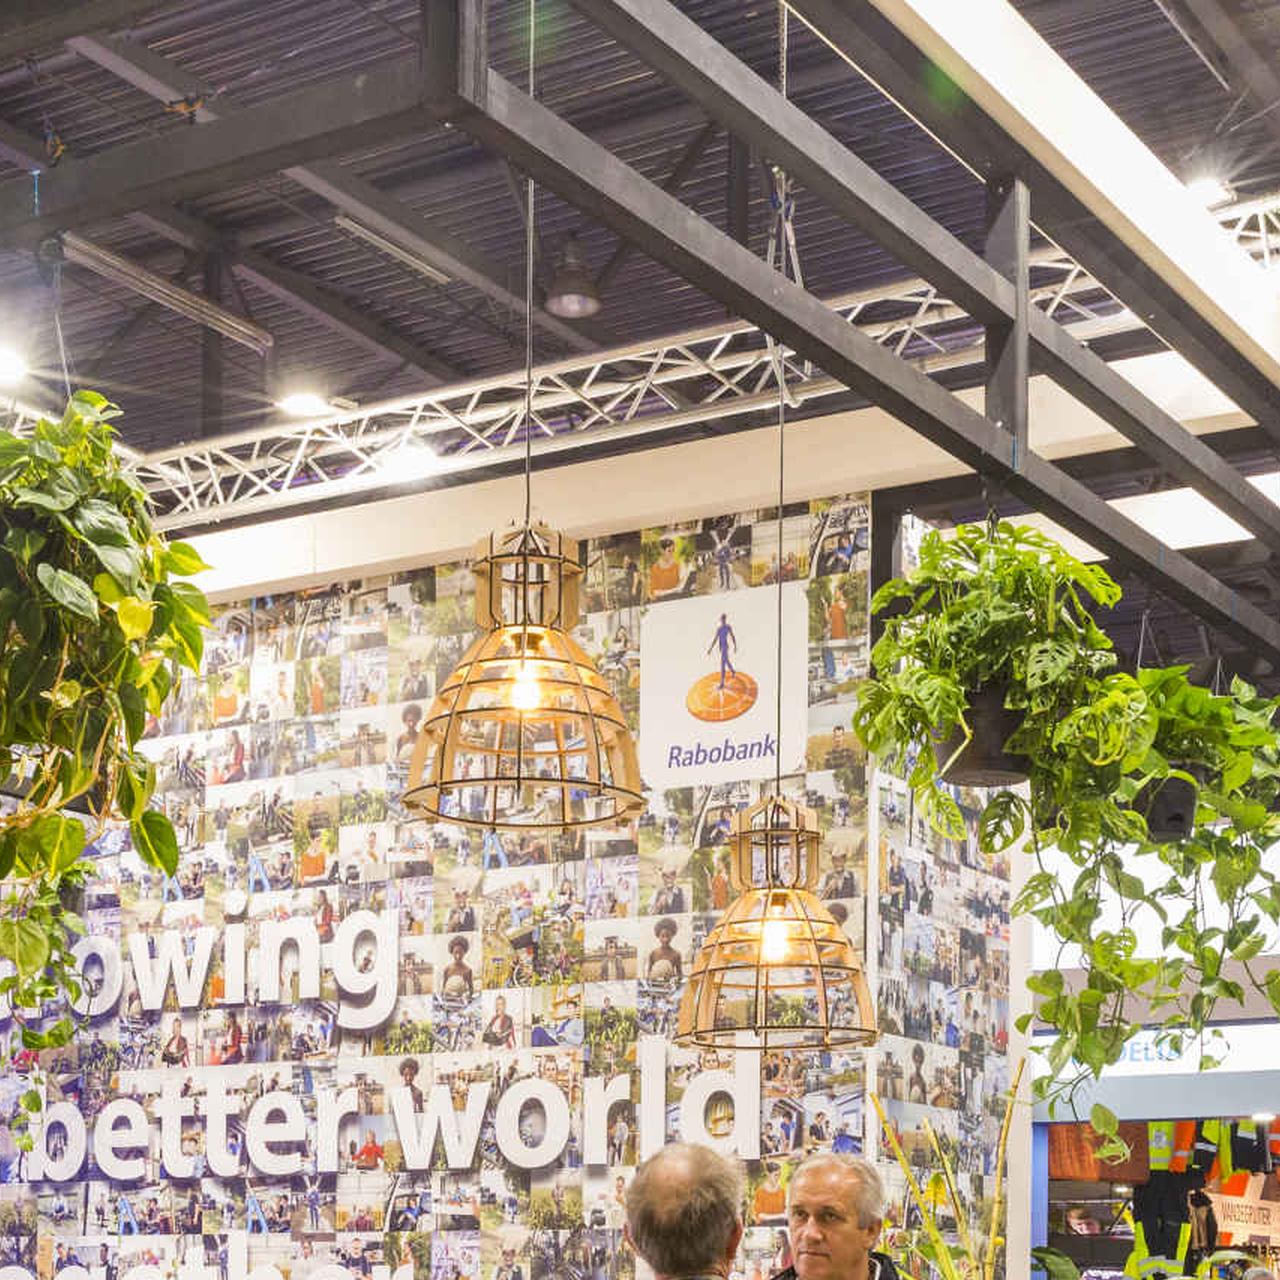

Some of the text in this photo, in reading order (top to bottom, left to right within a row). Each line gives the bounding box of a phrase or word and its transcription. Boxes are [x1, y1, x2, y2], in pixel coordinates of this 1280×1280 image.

[667, 733, 776, 769] Rabobank
[26, 1072, 359, 1183] better
[389, 1031, 761, 1168] world
